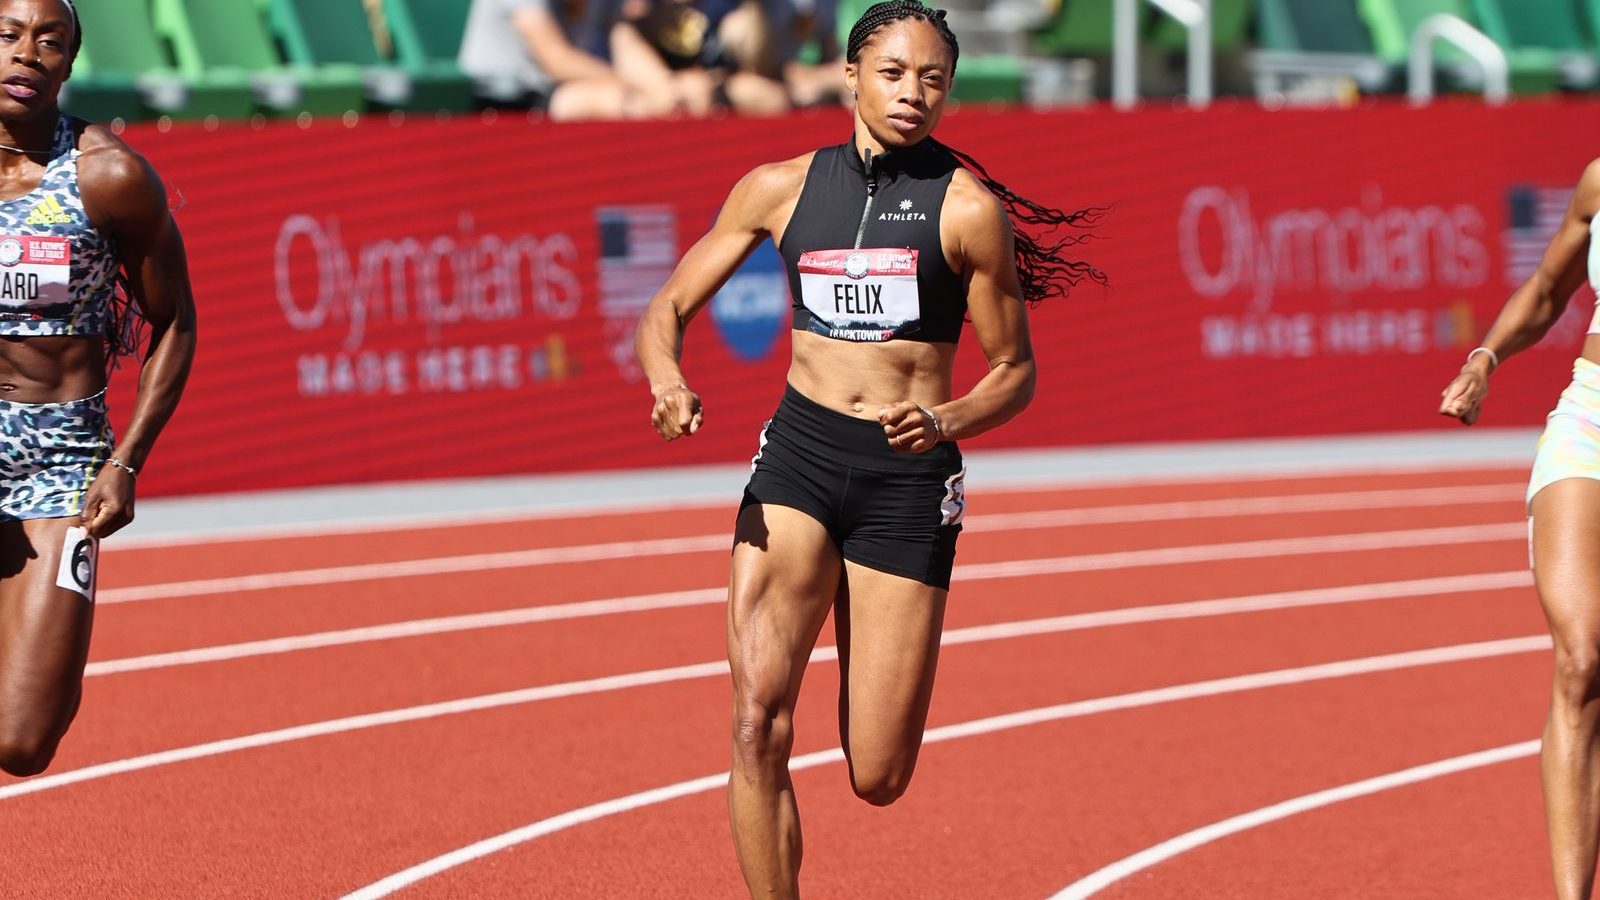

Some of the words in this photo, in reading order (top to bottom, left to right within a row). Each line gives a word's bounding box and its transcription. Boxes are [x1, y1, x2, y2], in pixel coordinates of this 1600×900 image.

[25, 212, 72, 225] adidas
[879, 212, 926, 221] ATHLETA
[1178, 183, 1490, 314] Olympians
[274, 210, 582, 351] Olympians
[834, 284, 884, 314] FELIX
[298, 350, 408, 396] MADE
[418, 344, 521, 388] HERE
[71, 538, 93, 590] 6
